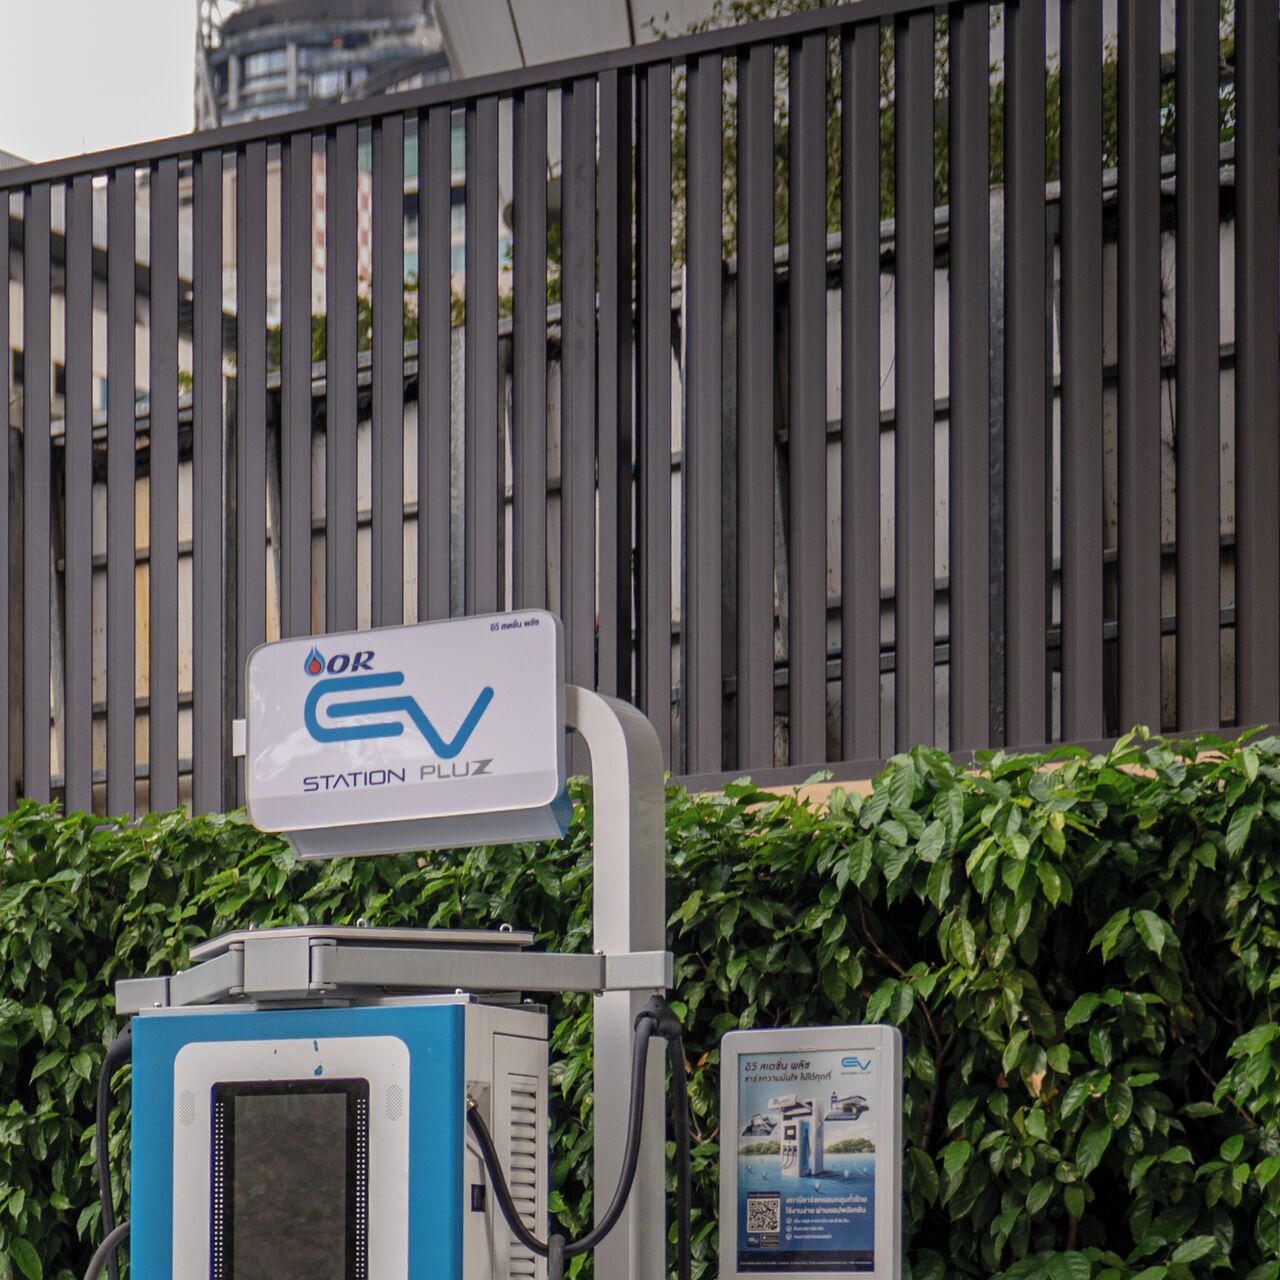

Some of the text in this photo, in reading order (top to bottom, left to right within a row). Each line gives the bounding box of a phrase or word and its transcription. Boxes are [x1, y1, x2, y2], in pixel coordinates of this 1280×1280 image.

[326, 651, 375, 675] OR
[304, 671, 495, 760] EV
[303, 758, 494, 792] STATION PLUZ
[841, 1056, 872, 1071] EV
